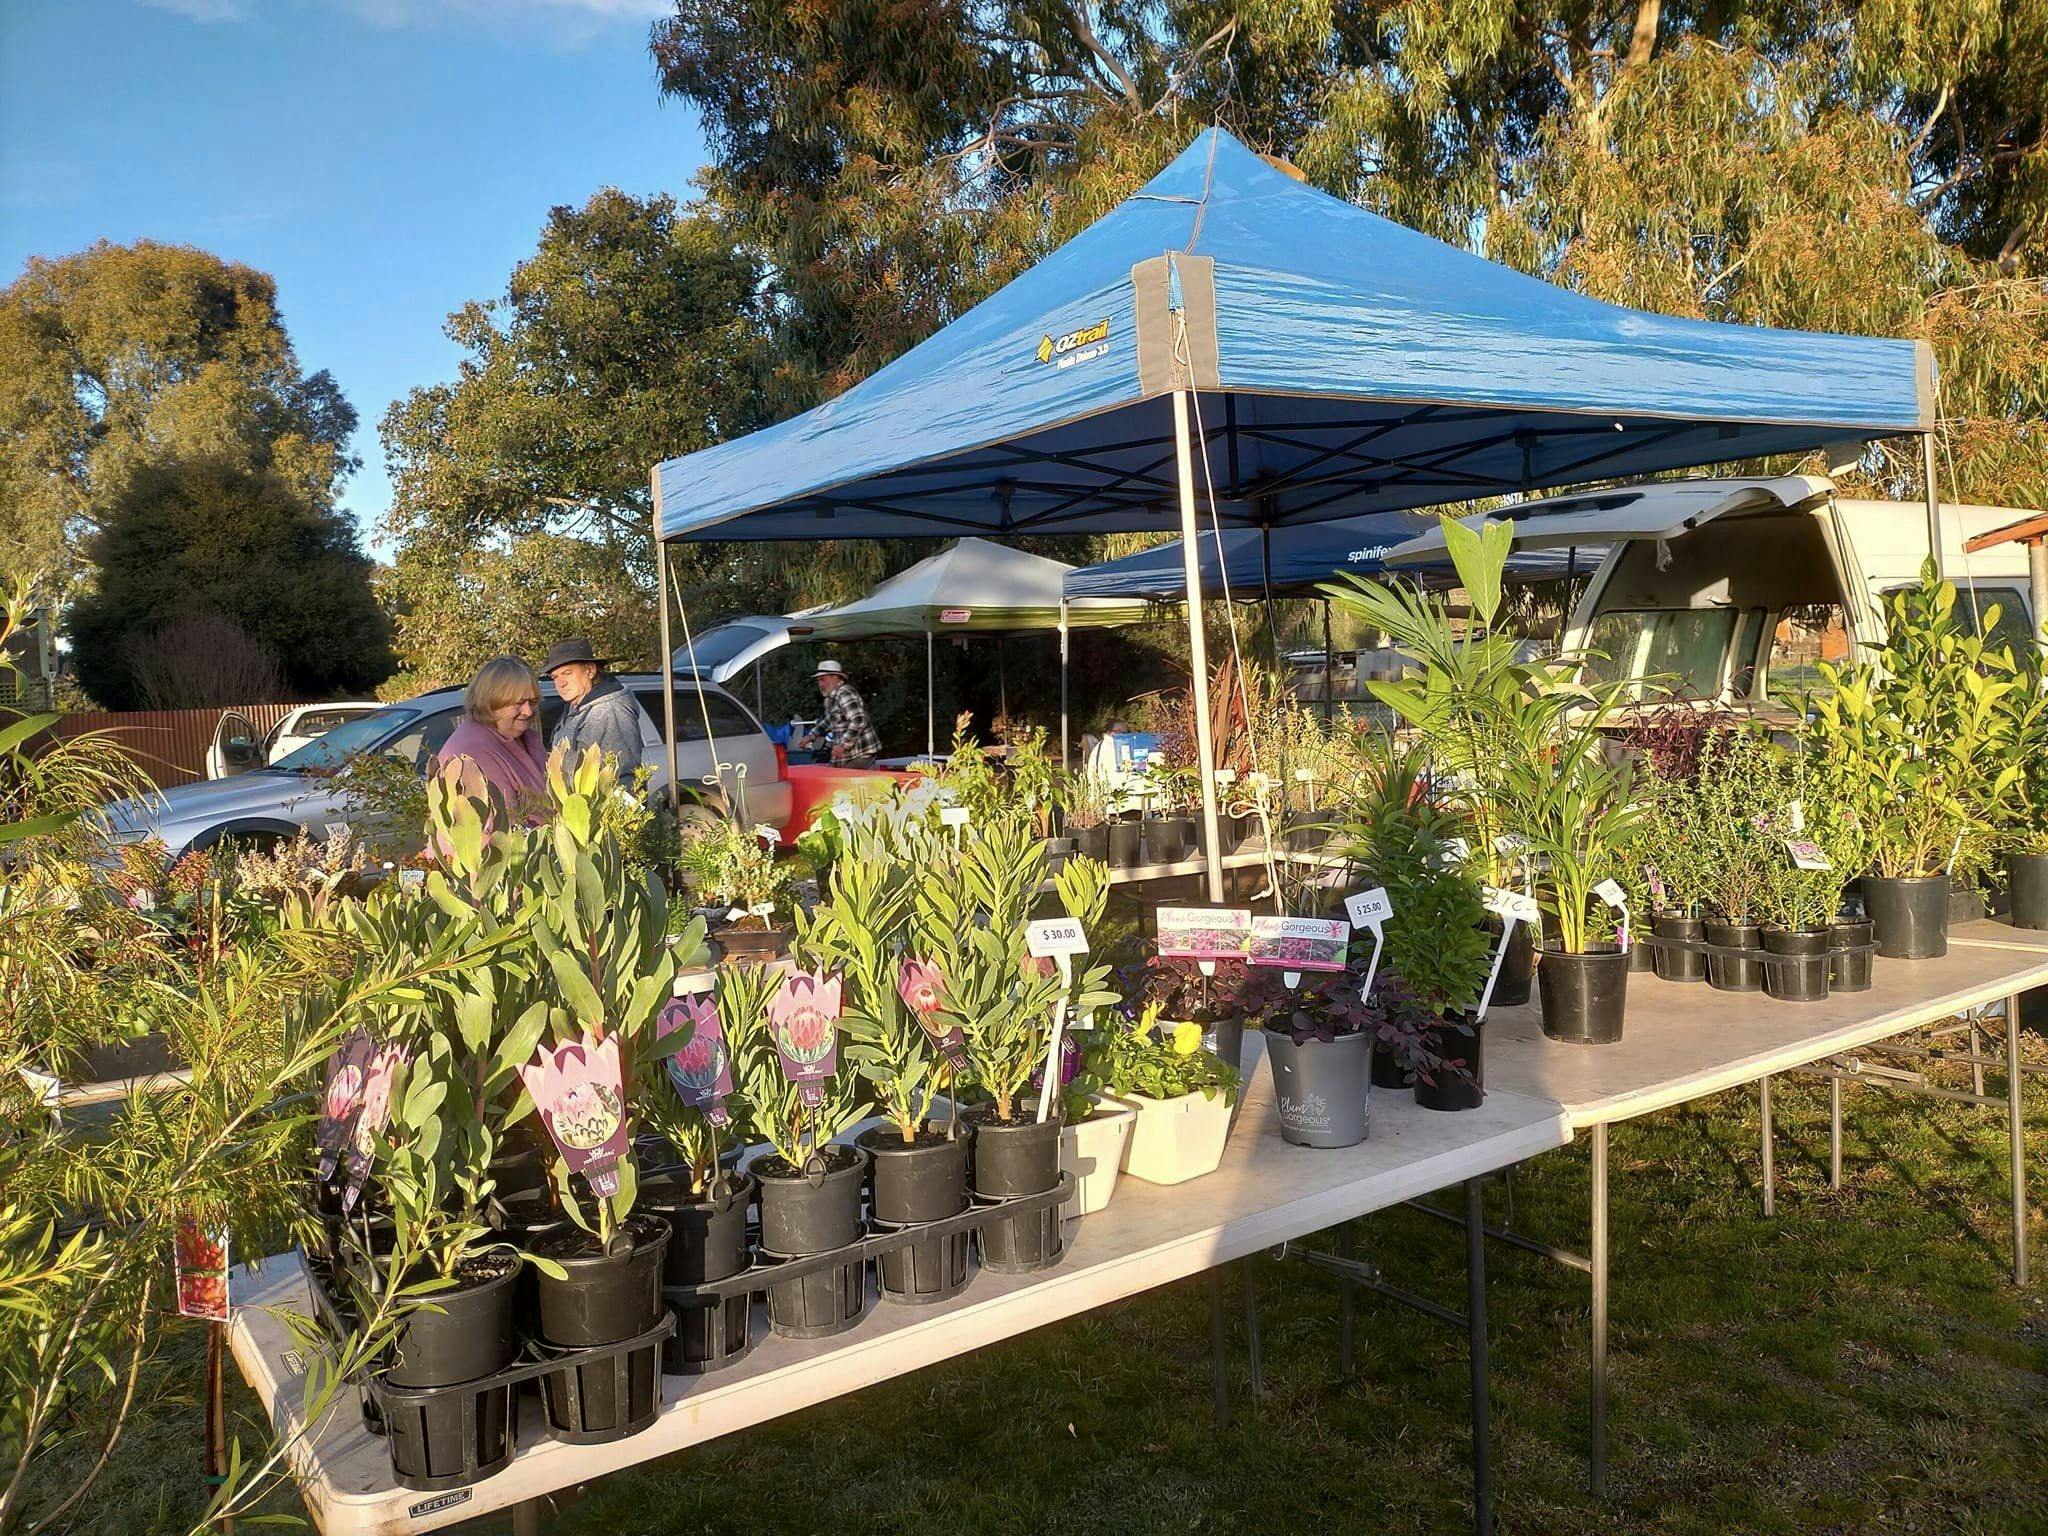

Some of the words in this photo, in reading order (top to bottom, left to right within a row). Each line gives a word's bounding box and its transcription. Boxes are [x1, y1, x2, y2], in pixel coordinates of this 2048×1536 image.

[1348, 546, 1391, 563] spinife
[1356, 905, 1362, 916] $
[1362, 901, 1382, 914] 25.00
[1187, 911, 1233, 925] Gorgeous
[1043, 930, 1050, 941] $
[1051, 928, 1076, 940] 30.00
[1281, 920, 1330, 934] Gorgeous
[1281, 1096, 1309, 1114] Plum
[1284, 1109, 1328, 1126] Gorgeous
[417, 1492, 465, 1513] LIFETIME
